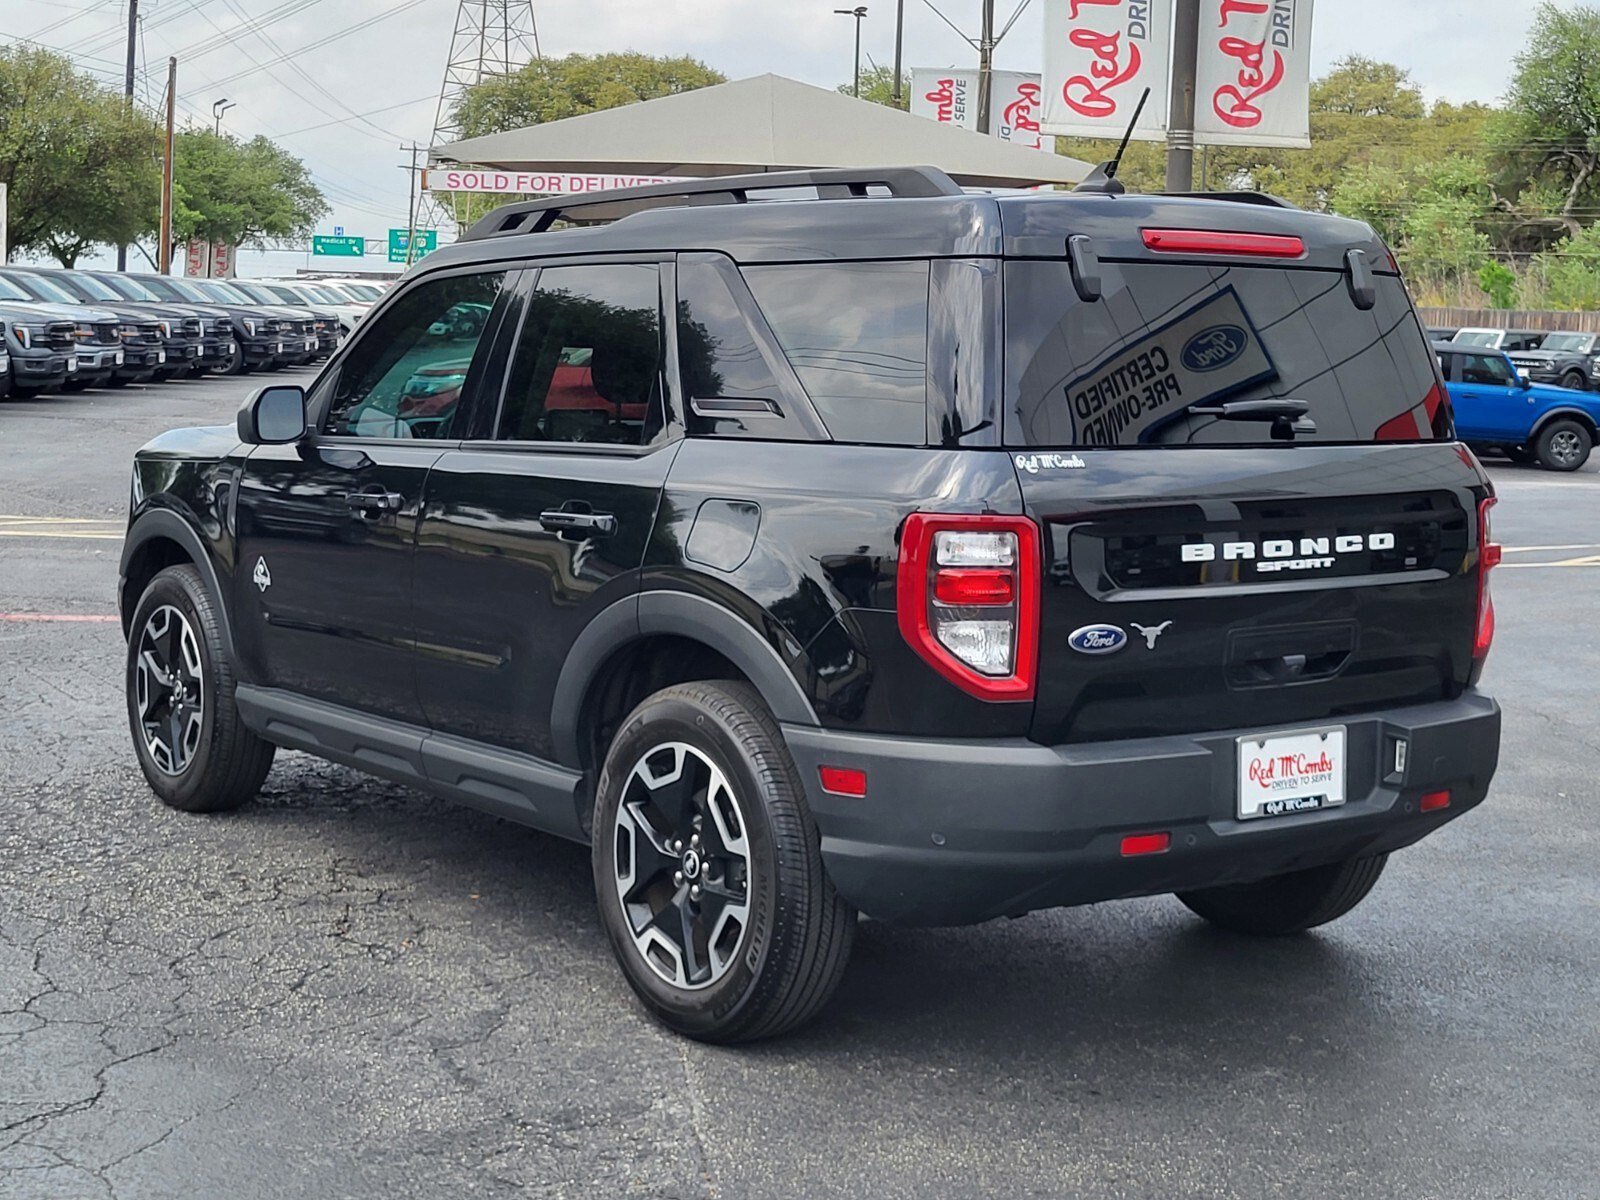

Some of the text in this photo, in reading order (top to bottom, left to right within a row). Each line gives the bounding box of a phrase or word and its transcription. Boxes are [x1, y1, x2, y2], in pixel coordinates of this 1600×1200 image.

[1063, 28, 1141, 118] Red
[1213, 36, 1284, 128] Red
[954, 78, 966, 121] SERVE
[446, 173, 672, 193] SOLD FOR DELIV
[1015, 454, 1039, 474] Red
[1181, 533, 1395, 562] BRONCO
[1256, 557, 1336, 572] SPORT
[1249, 751, 1333, 788] Red McCombs
[1272, 773, 1332, 789] DRIVEN TO SERVE
[749, 874, 768, 967] MICHELIN
